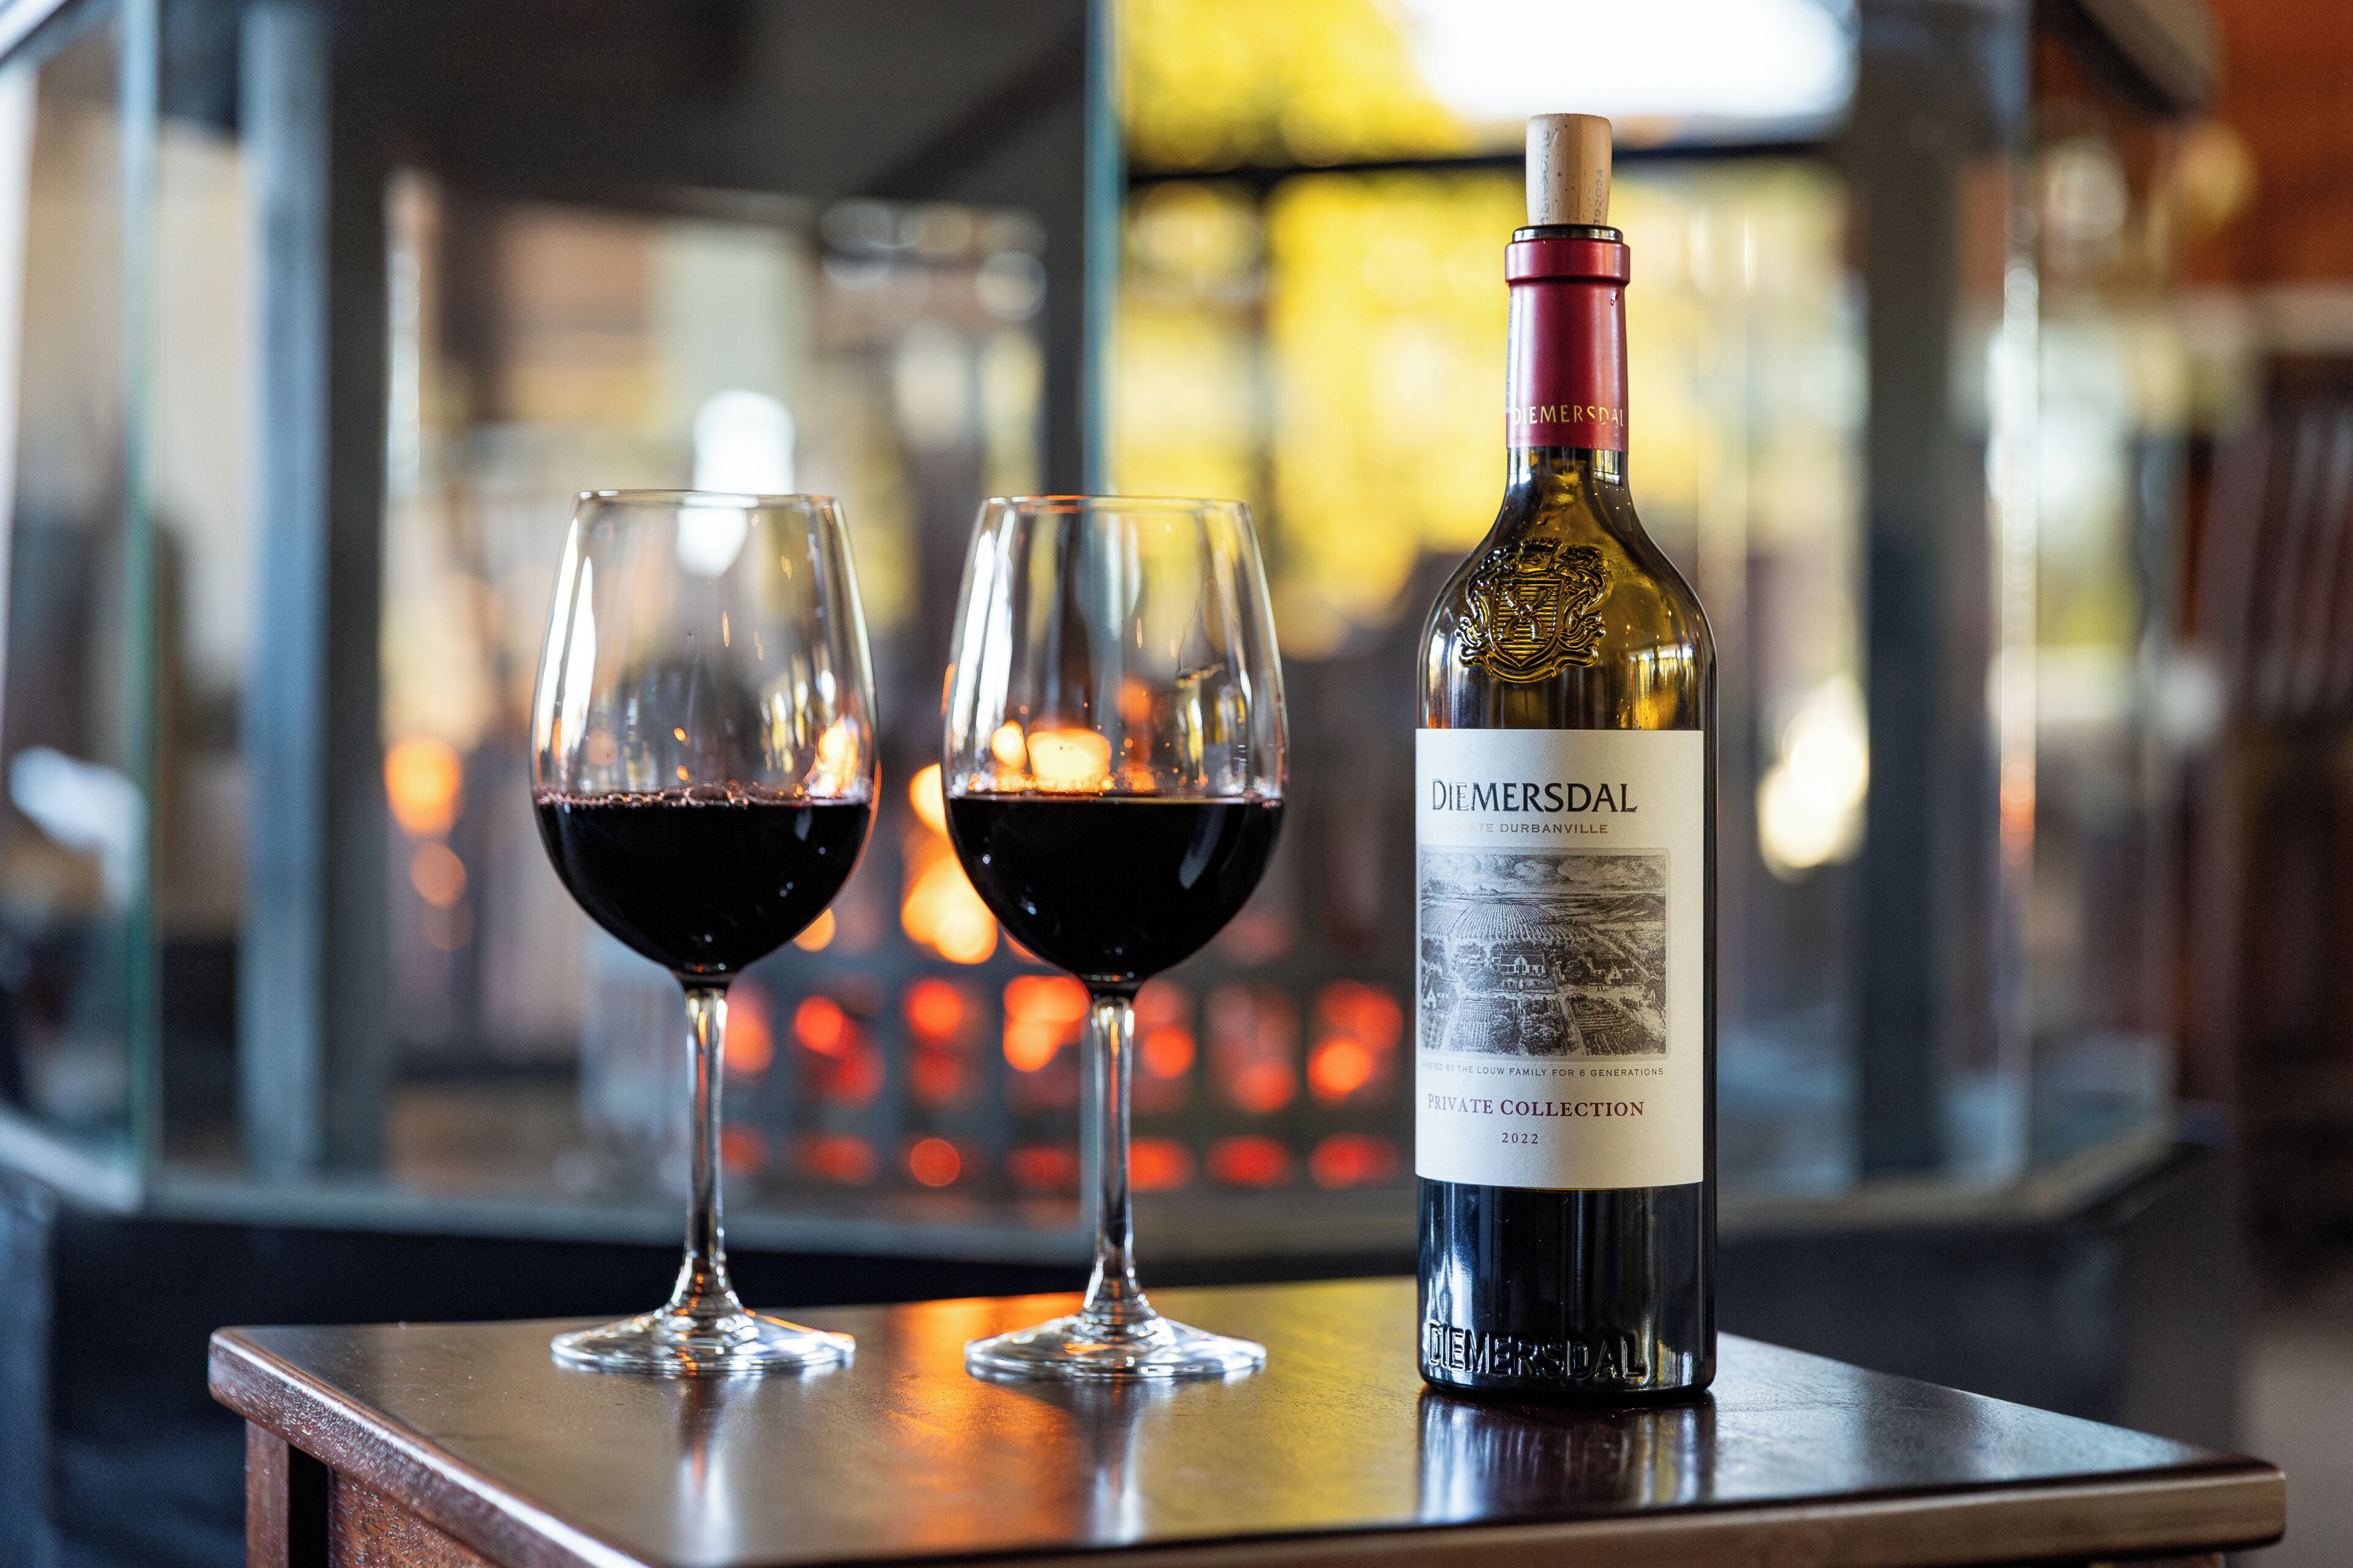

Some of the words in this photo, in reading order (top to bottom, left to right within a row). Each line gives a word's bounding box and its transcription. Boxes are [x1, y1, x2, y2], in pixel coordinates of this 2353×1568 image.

[1432, 778, 1638, 812] DIEMERSDAL
[1500, 824, 1608, 834] DURBANVILLE
[1477, 1066, 1505, 1075] LOUW
[1509, 1068, 1547, 1077] FAMILY
[1590, 1068, 1664, 1077] GENERATIONS
[1428, 1093, 1494, 1115] PRIVATE
[1500, 1099, 1645, 1117] COLLECTION
[1501, 1132, 1539, 1144] 2022
[1428, 1319, 1647, 1380] DIEMERSDAL
